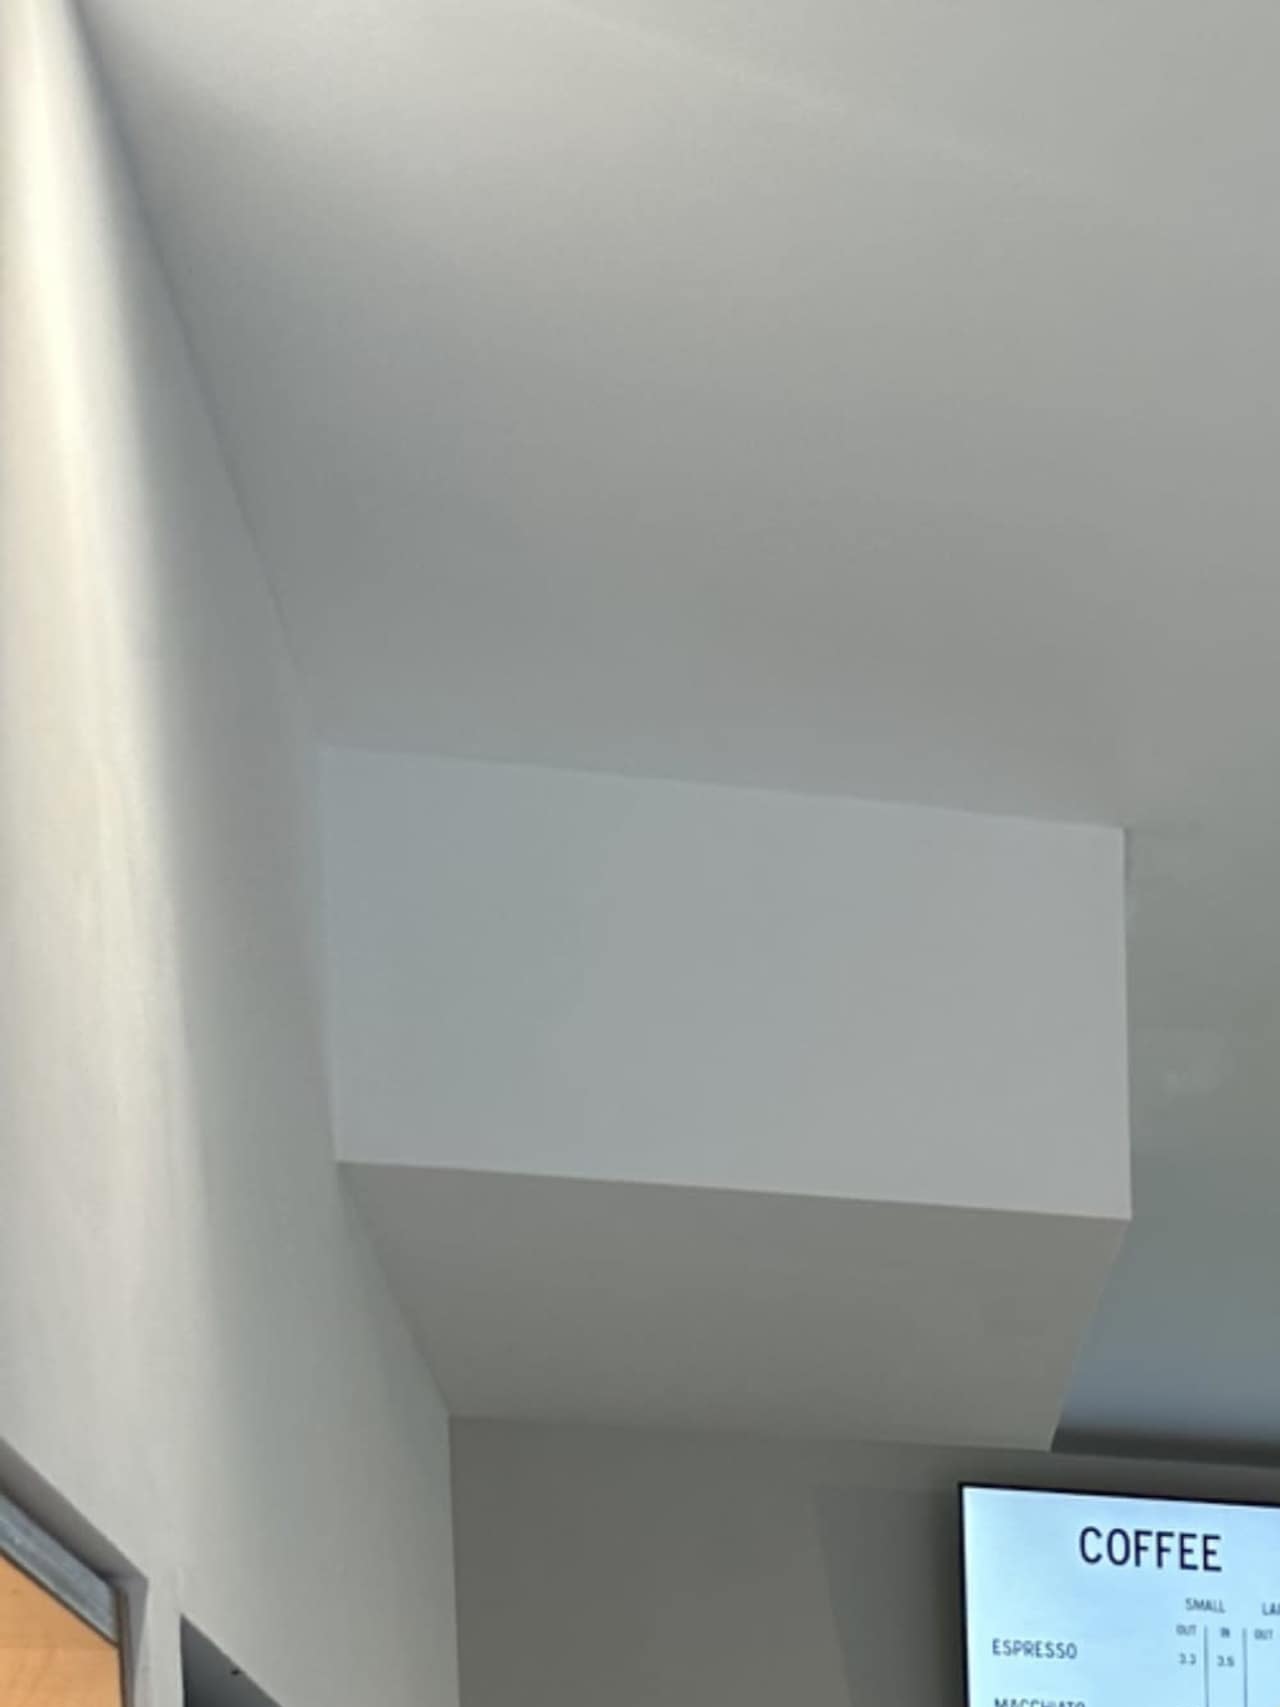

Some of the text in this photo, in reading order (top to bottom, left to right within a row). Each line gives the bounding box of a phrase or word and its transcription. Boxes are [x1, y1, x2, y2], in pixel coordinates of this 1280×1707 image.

[1079, 1526, 1222, 1572] COFFEE
[1185, 1598, 1226, 1613] SMALL
[993, 1639, 1078, 1659] ESPRESSO
